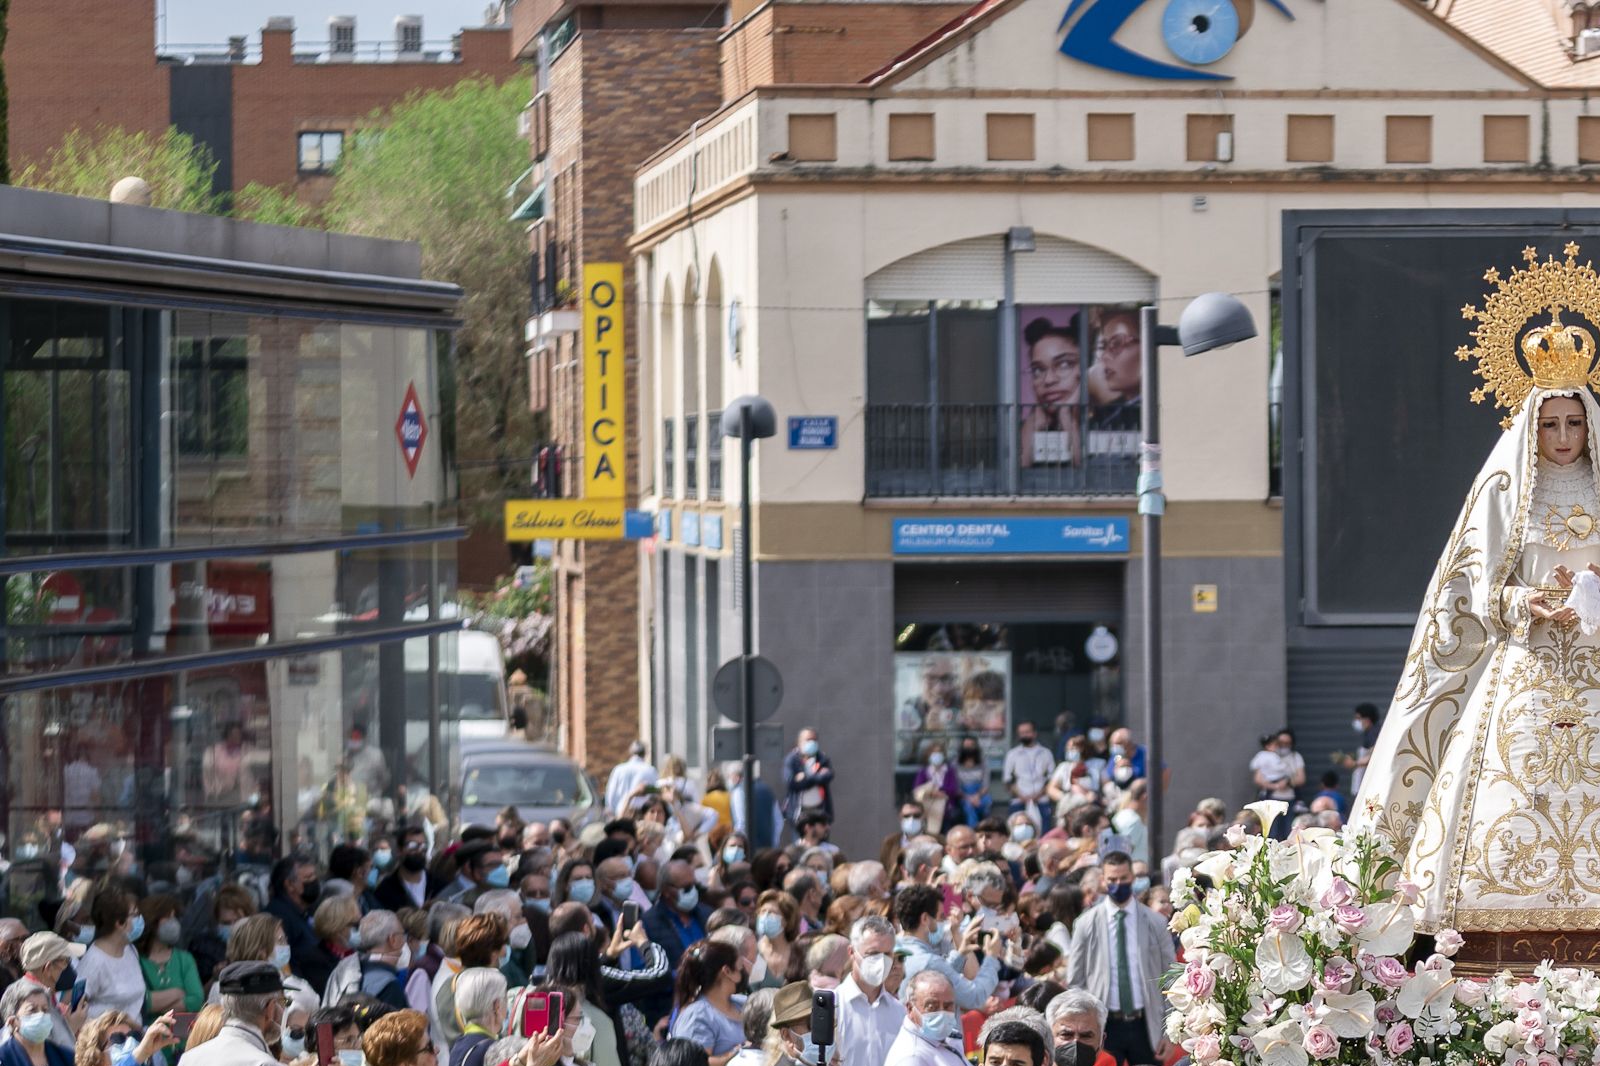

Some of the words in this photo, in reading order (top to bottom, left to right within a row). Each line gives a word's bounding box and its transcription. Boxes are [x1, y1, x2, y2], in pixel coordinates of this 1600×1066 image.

[590, 280, 616, 480] OPTICA
[512, 511, 566, 529] Silvia
[900, 523, 954, 537] CENTRO
[957, 523, 1010, 537] DENTAL
[1062, 525, 1104, 538] Sanitas
